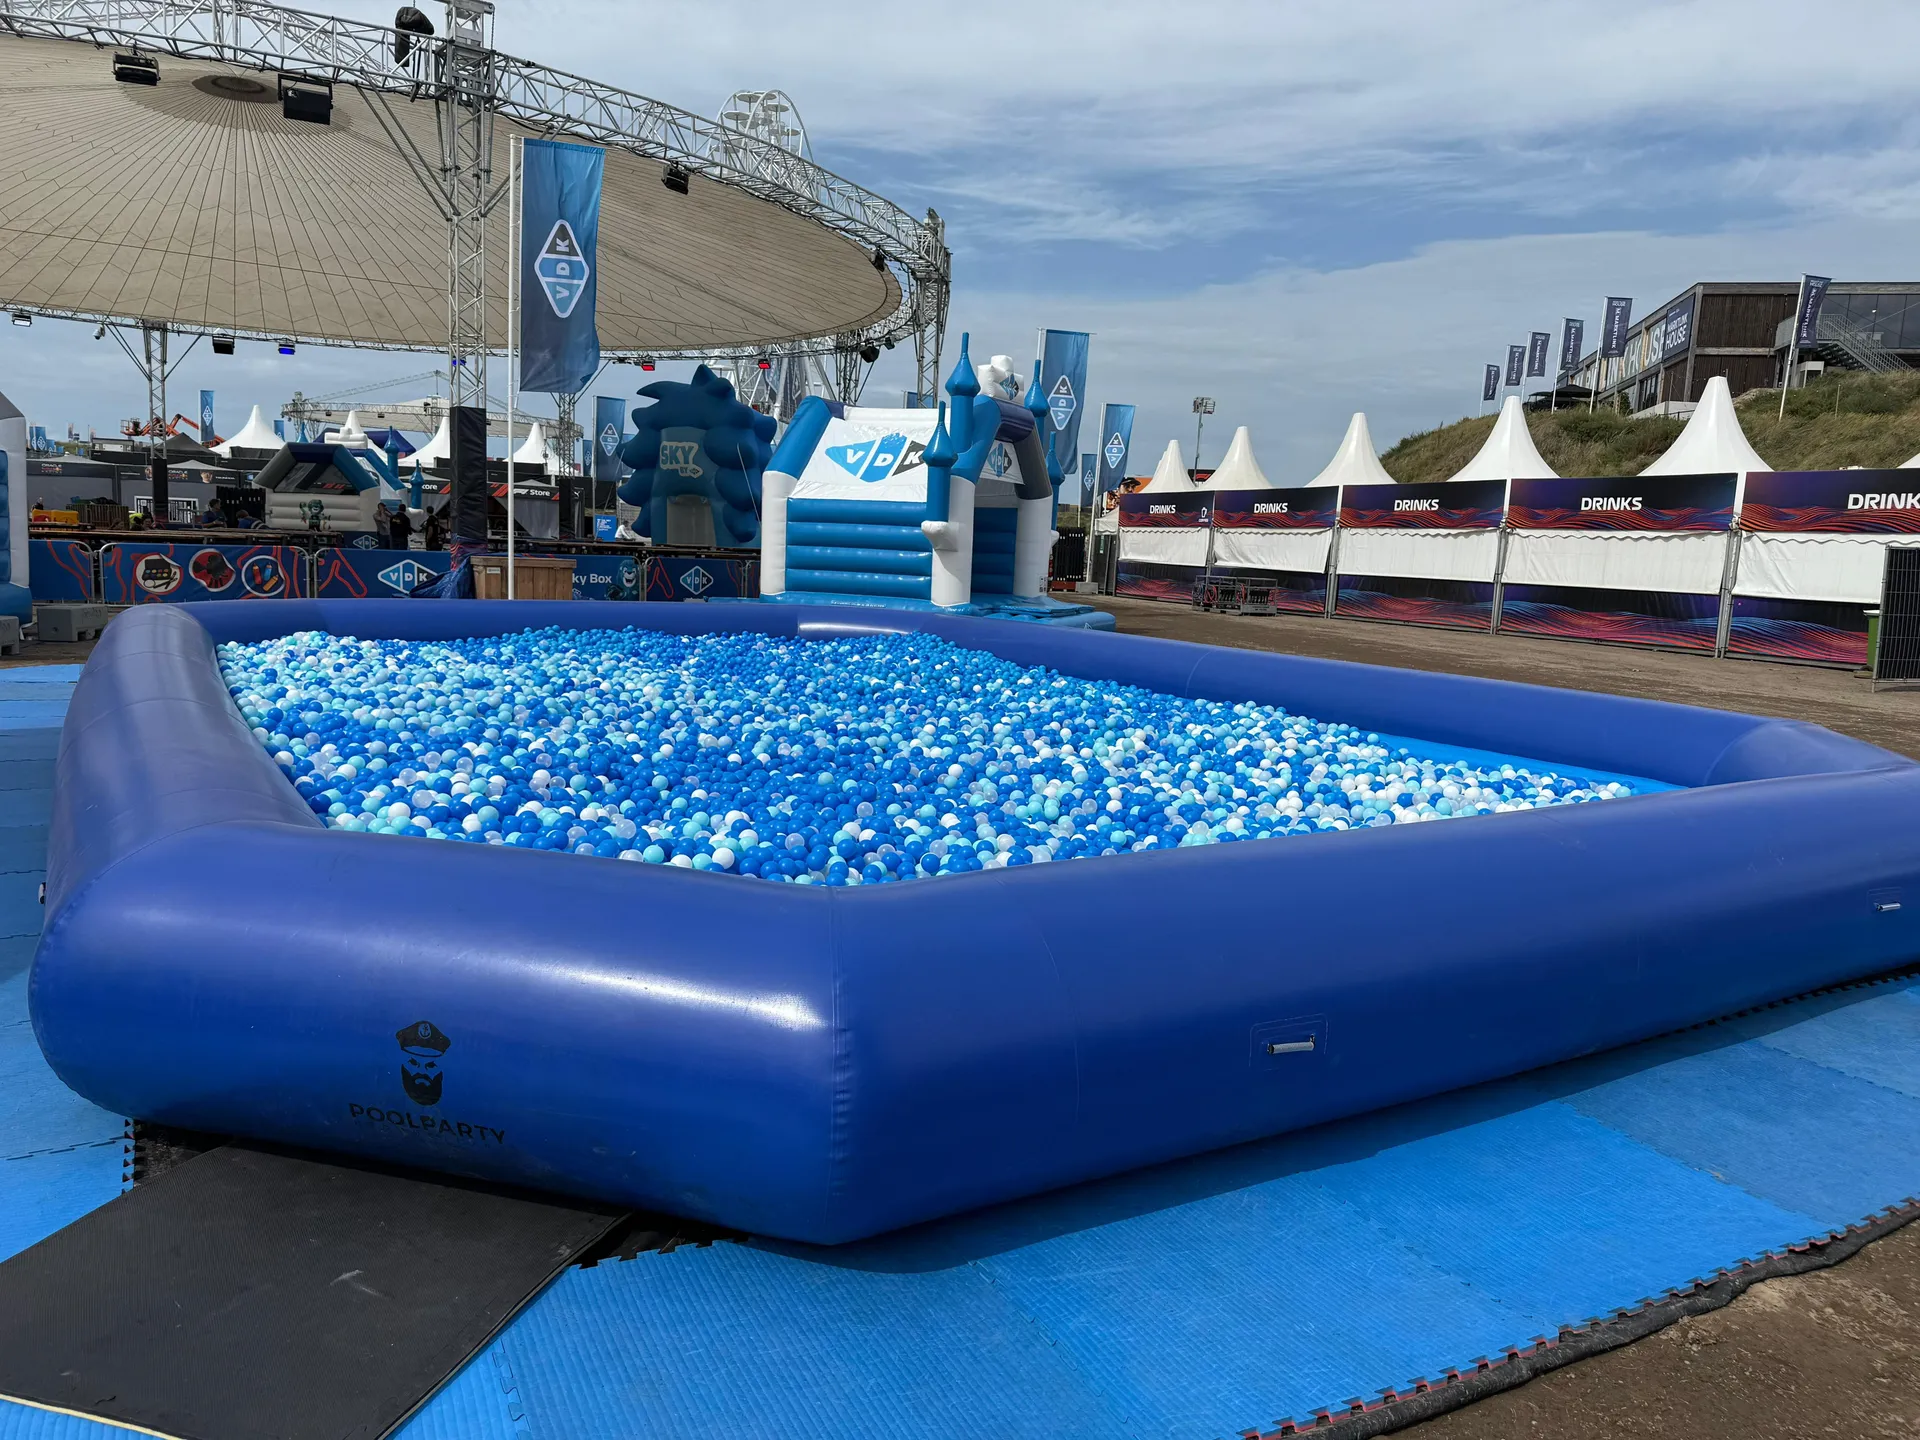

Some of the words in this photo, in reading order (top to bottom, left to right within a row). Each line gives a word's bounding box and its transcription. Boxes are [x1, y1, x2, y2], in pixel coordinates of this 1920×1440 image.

[556, 237, 570, 299] VDK
[1665, 324, 1687, 350] HOUSE
[1057, 385, 1068, 420] VDK
[661, 445, 695, 465] SKY
[846, 448, 924, 466] VDK
[1110, 439, 1119, 462] VDK
[530, 489, 551, 497] Store
[1150, 504, 1176, 514] DRINKS
[1254, 503, 1288, 514] DRINKS
[1394, 499, 1440, 511] DRINKS
[1581, 497, 1643, 511] DRINKS
[1847, 493, 1920, 510] DRINK
[389, 572, 428, 581] VDK
[572, 573, 586, 586] ky
[590, 574, 612, 584] Box
[686, 576, 708, 584] VDK
[349, 1103, 505, 1145] POOLPARTY
